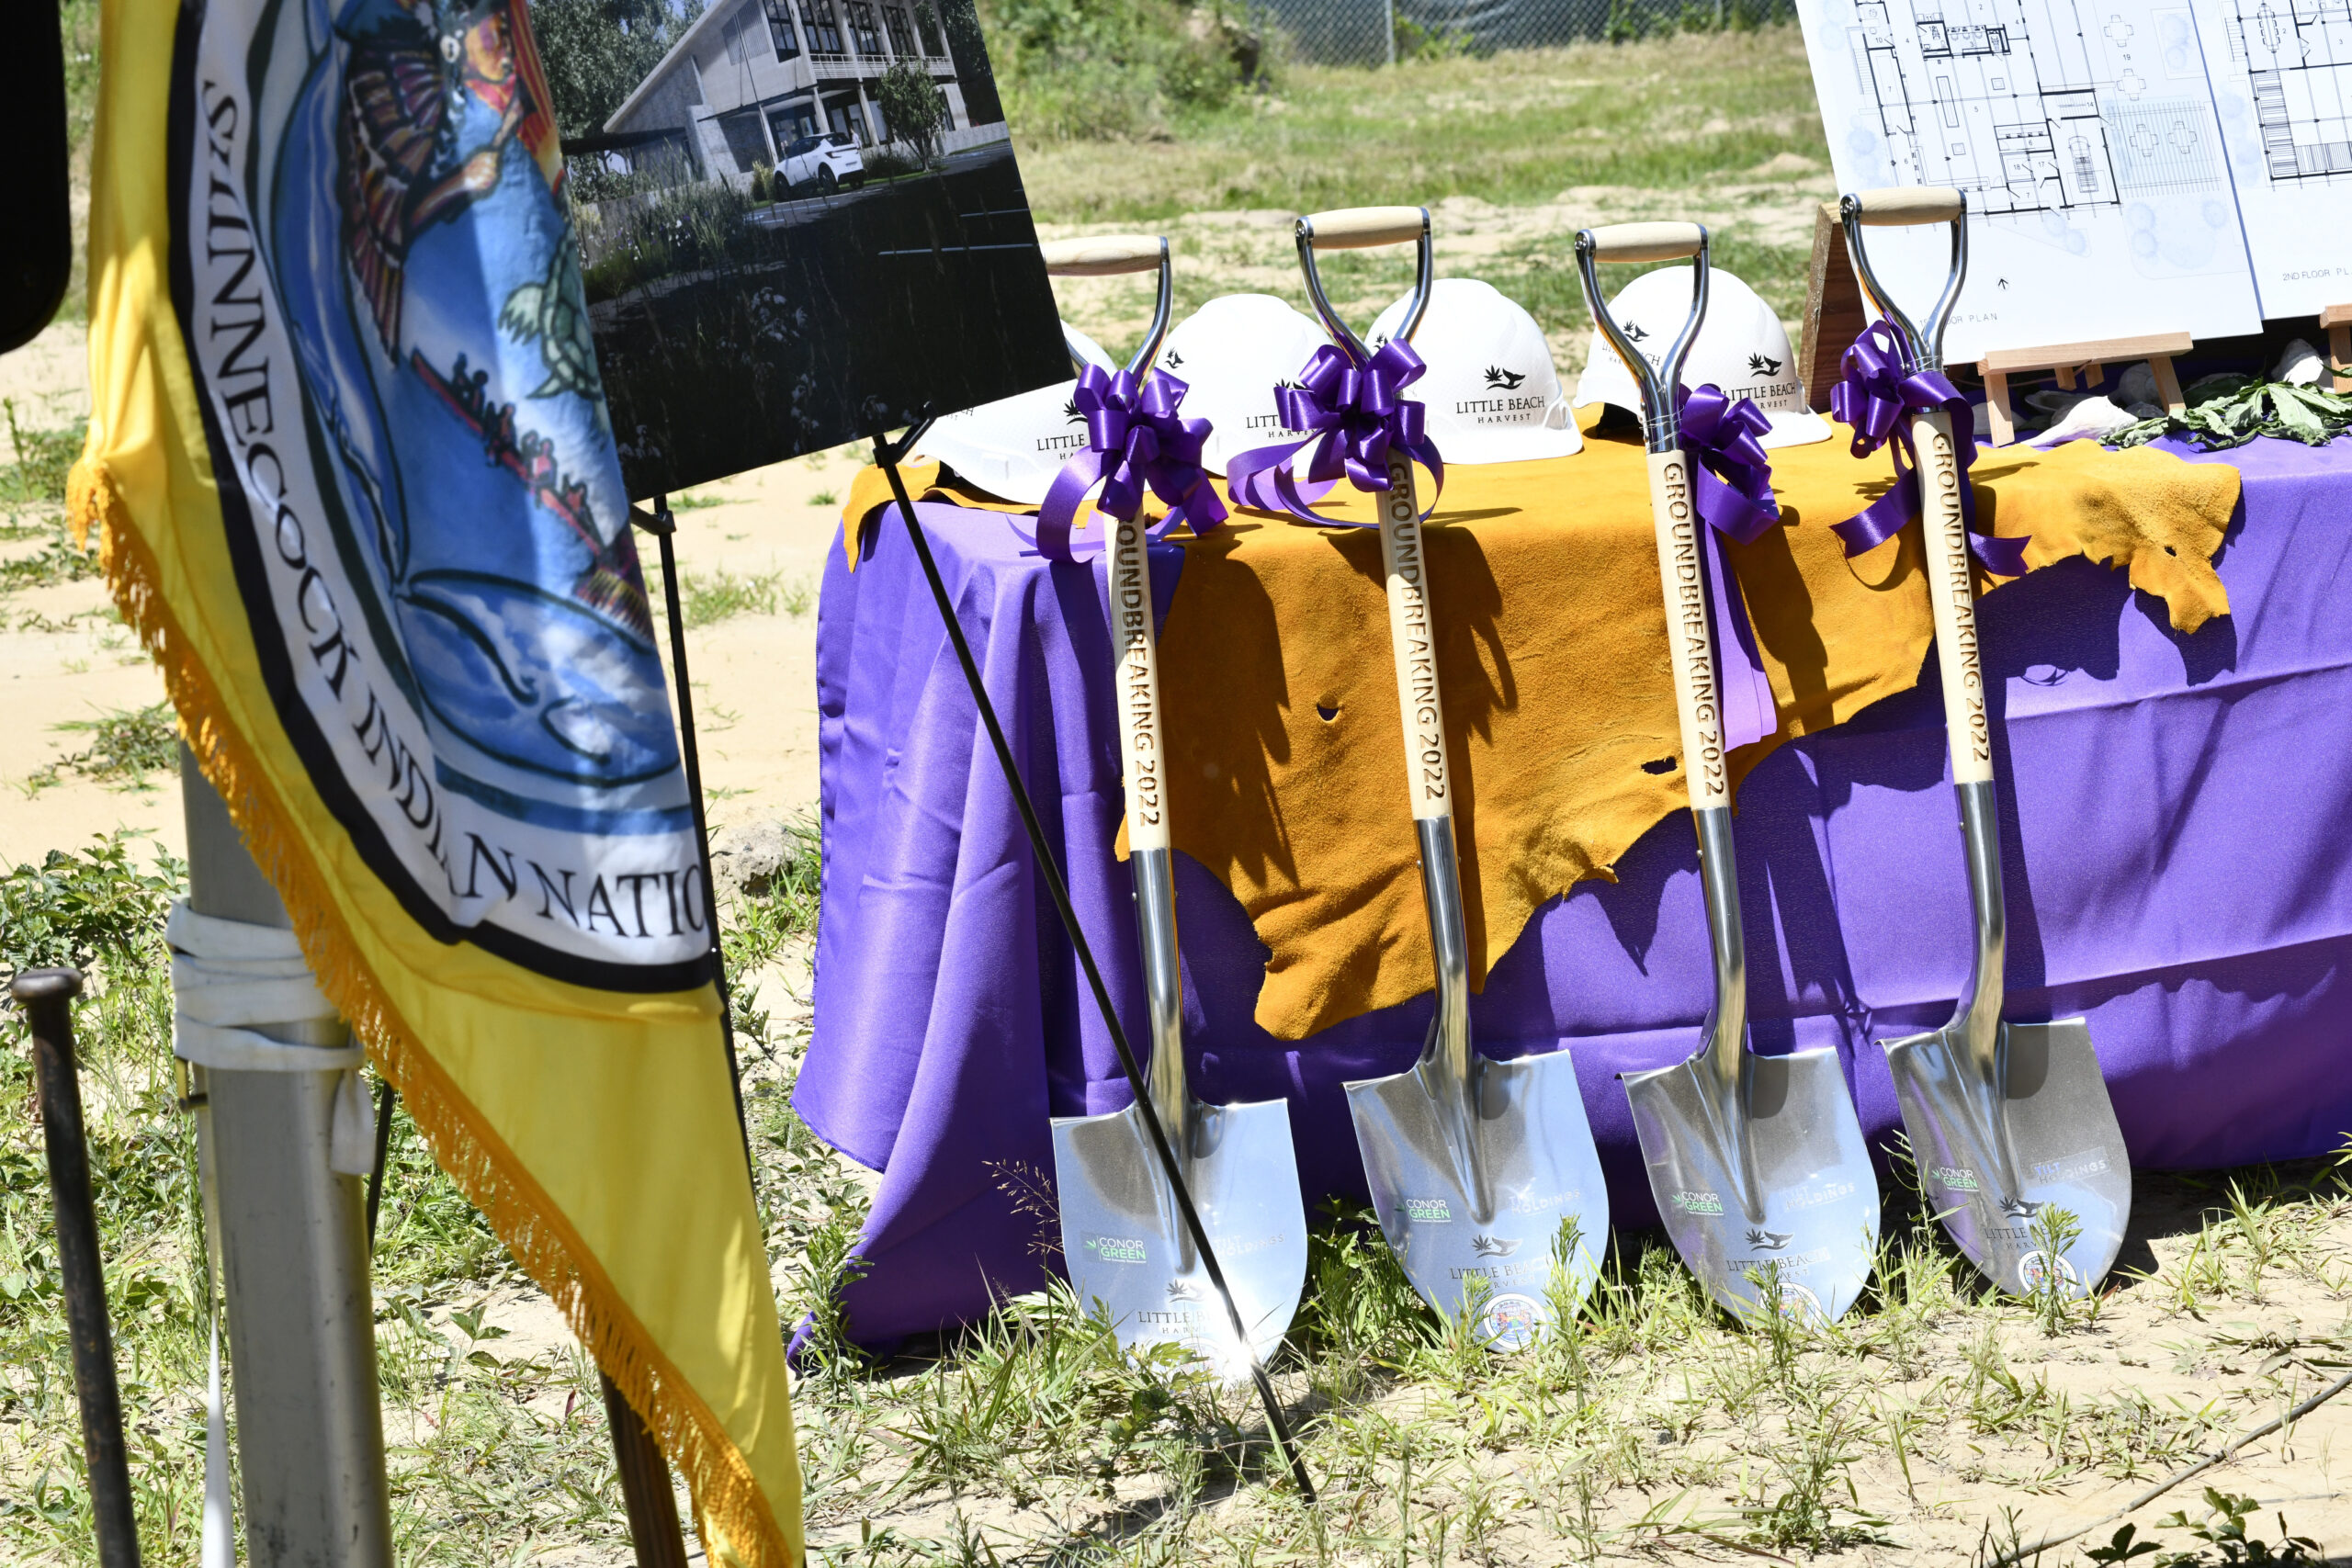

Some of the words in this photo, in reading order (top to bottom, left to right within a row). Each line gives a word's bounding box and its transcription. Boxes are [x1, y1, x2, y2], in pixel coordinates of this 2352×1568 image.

[2282, 272, 2300, 281] 2ND
[2301, 269, 2331, 279] FLOOR
[2335, 267, 2352, 276] PL
[1969, 312, 1997, 322] PLAN
[1723, 386, 1767, 401] LITTLE
[1770, 382, 1796, 398] BEACH
[1456, 399, 1504, 414] LITTLE
[1508, 395, 1545, 411] BEACH
[1760, 400, 1788, 409] RVEST
[1246, 414, 1279, 429] LITT
[1477, 412, 1532, 424] HARVEST
[1268, 429, 1316, 438] HARVES
[1036, 434, 1085, 451] LITTLE
[1932, 432, 1983, 690] GROUNDBREAKING
[1966, 697, 1990, 762] 2022
[1388, 462, 1440, 726] GROUNDBREAKING
[1419, 734, 1445, 802] 2022
[1664, 462, 1716, 724] GROUNDBREAKING
[1699, 731, 1724, 797] 2022
[1116, 521, 1155, 752] OUNDBREAKING
[1136, 760, 1161, 828] 2022
[526, 863, 707, 938] NATIO
[1939, 1168, 1974, 1179] CONOR
[2034, 1161, 2061, 1177] TILT
[1943, 1177, 1978, 1188] GREEN
[1681, 1191, 1720, 1202] CONOR
[1406, 1199, 1447, 1209] CONOR
[1684, 1201, 1724, 1213] GREEN
[1408, 1208, 1451, 1219] GREEN
[1984, 1226, 2028, 1239] LITTLE
[1099, 1236, 1145, 1250] CONOR
[2007, 1240, 2039, 1250] HARV
[1100, 1247, 1148, 1260] GREEN
[1777, 1247, 1831, 1269] BEACH
[1776, 1269, 1809, 1280] VEST
[1493, 1276, 1535, 1289] RVEST
[1138, 1311, 1192, 1324] LITTLE
